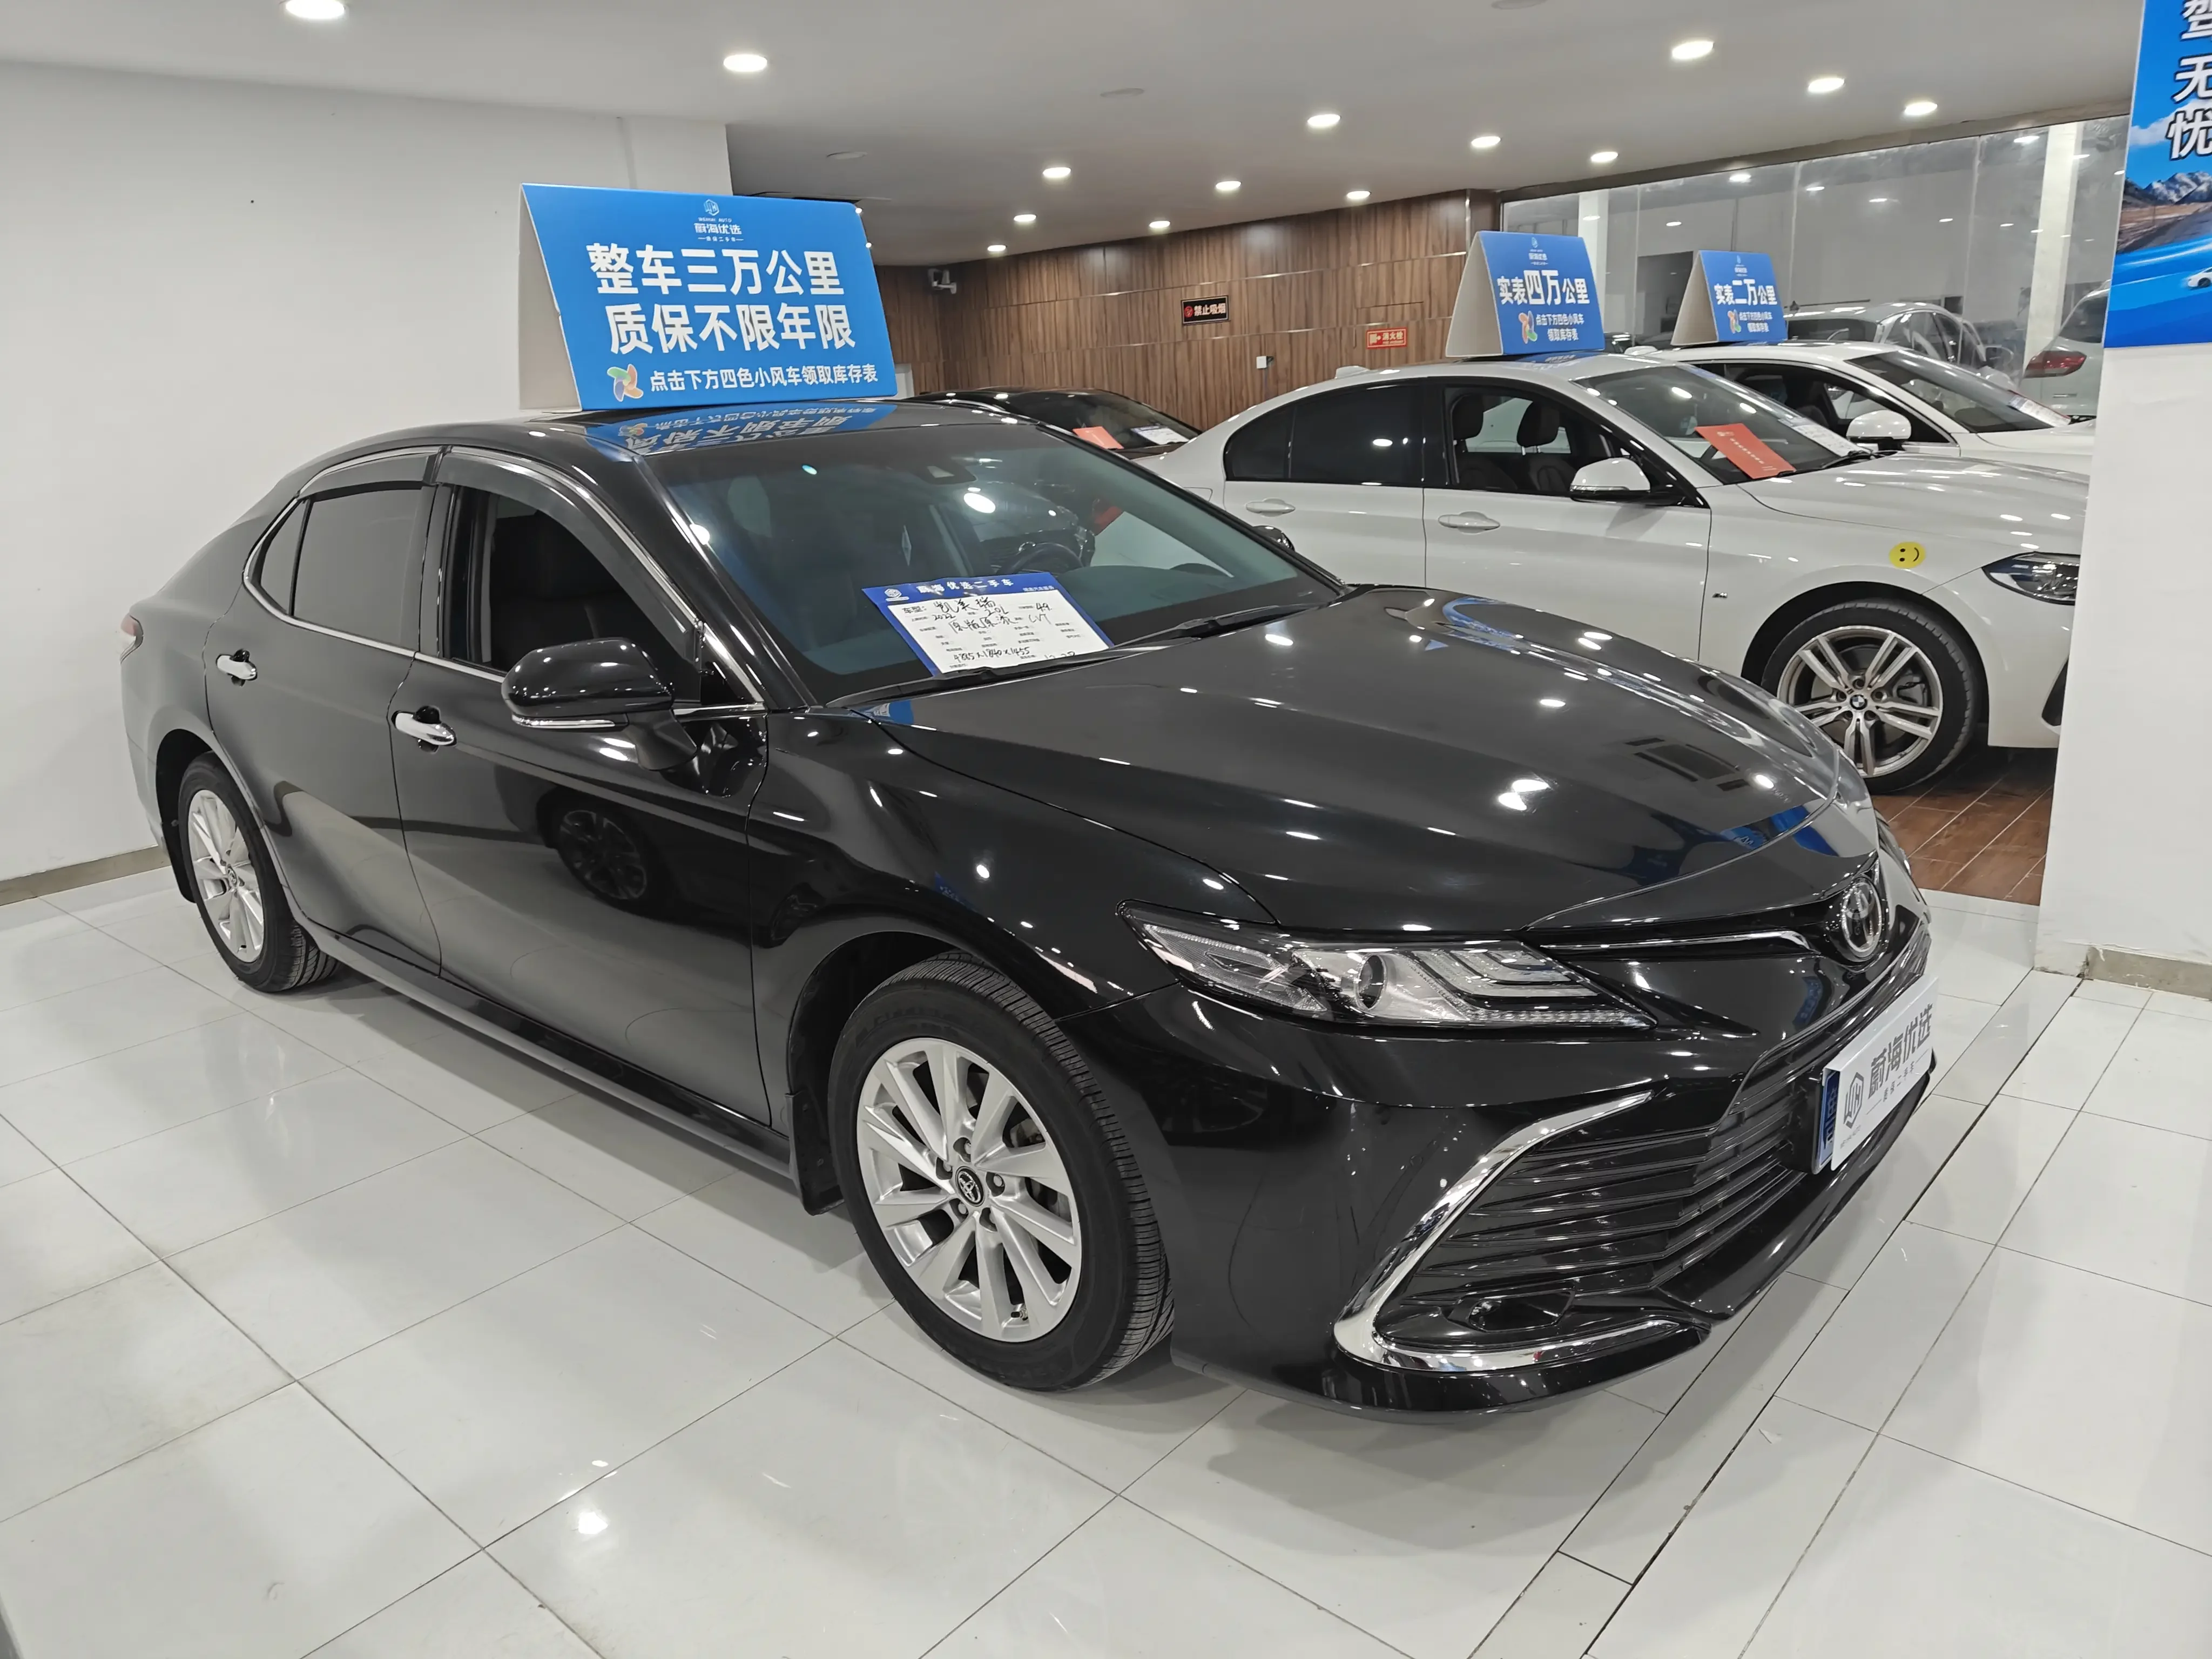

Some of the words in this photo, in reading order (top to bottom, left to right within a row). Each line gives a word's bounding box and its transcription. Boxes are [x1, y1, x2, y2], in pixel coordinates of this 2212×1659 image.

[586, 242, 844, 295] 整车三万公里
[1496, 269, 1590, 306] 实表四万公里
[1714, 279, 1778, 306] 实表二万公里
[1194, 302, 1226, 316] 禁止吸烟
[605, 302, 855, 354] 质保不限年限
[650, 363, 879, 393] 点击下方四色小风车领取库存表
[932, 612, 956, 621] 2022
[1868, 1003, 1933, 1100] 蔚海优选
